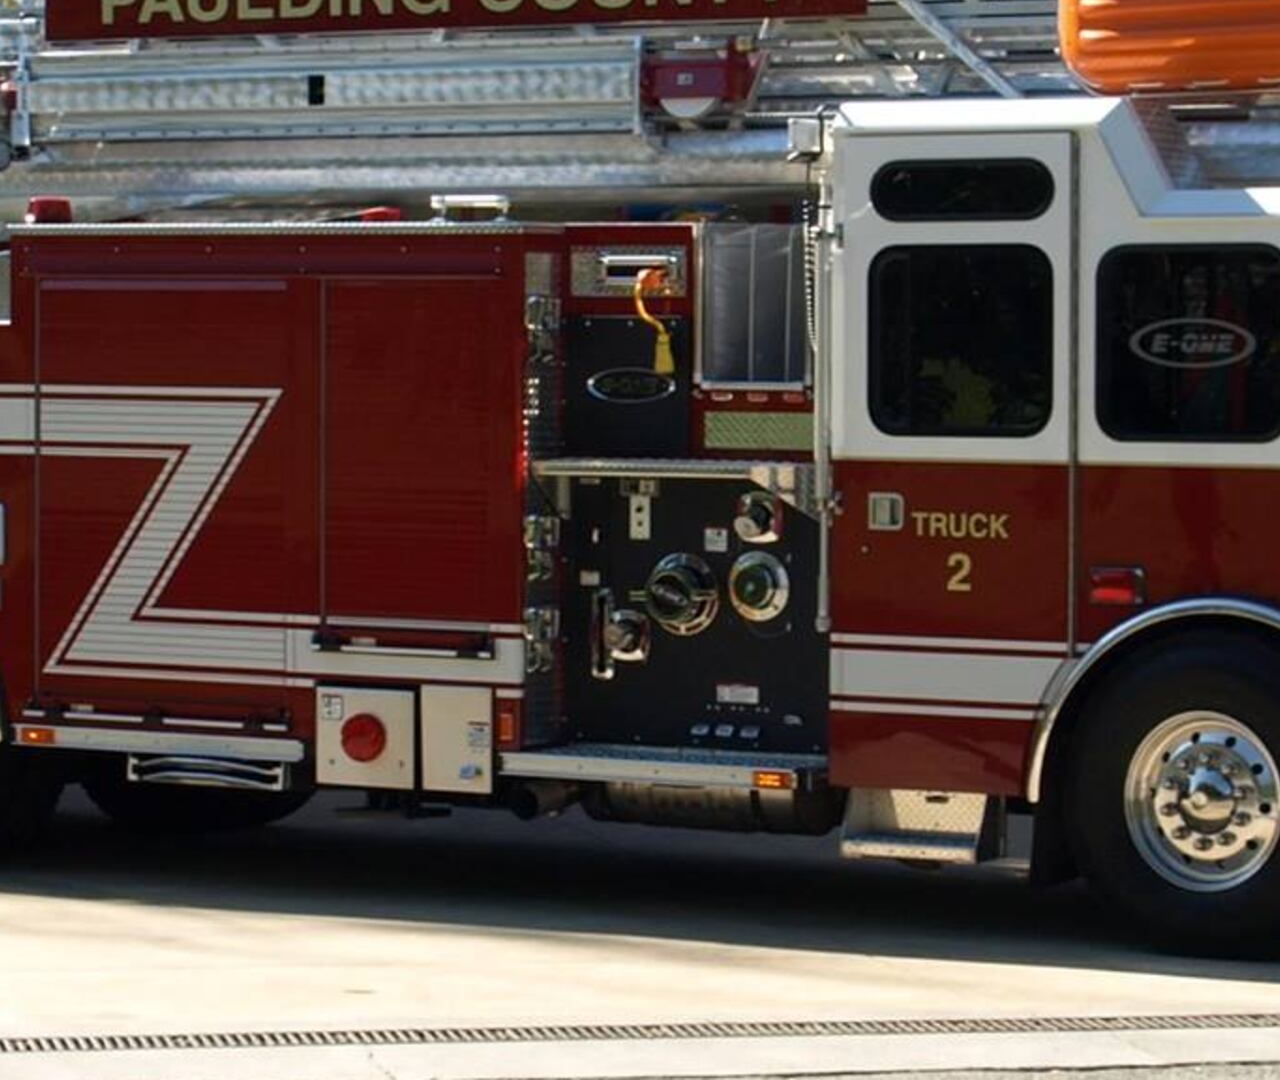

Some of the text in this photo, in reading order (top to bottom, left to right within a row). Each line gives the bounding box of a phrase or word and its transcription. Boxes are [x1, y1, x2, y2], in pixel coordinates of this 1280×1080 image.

[1149, 332, 1236, 354] E-ONE
[910, 511, 1010, 539] TRUCK
[946, 552, 972, 592] 2
